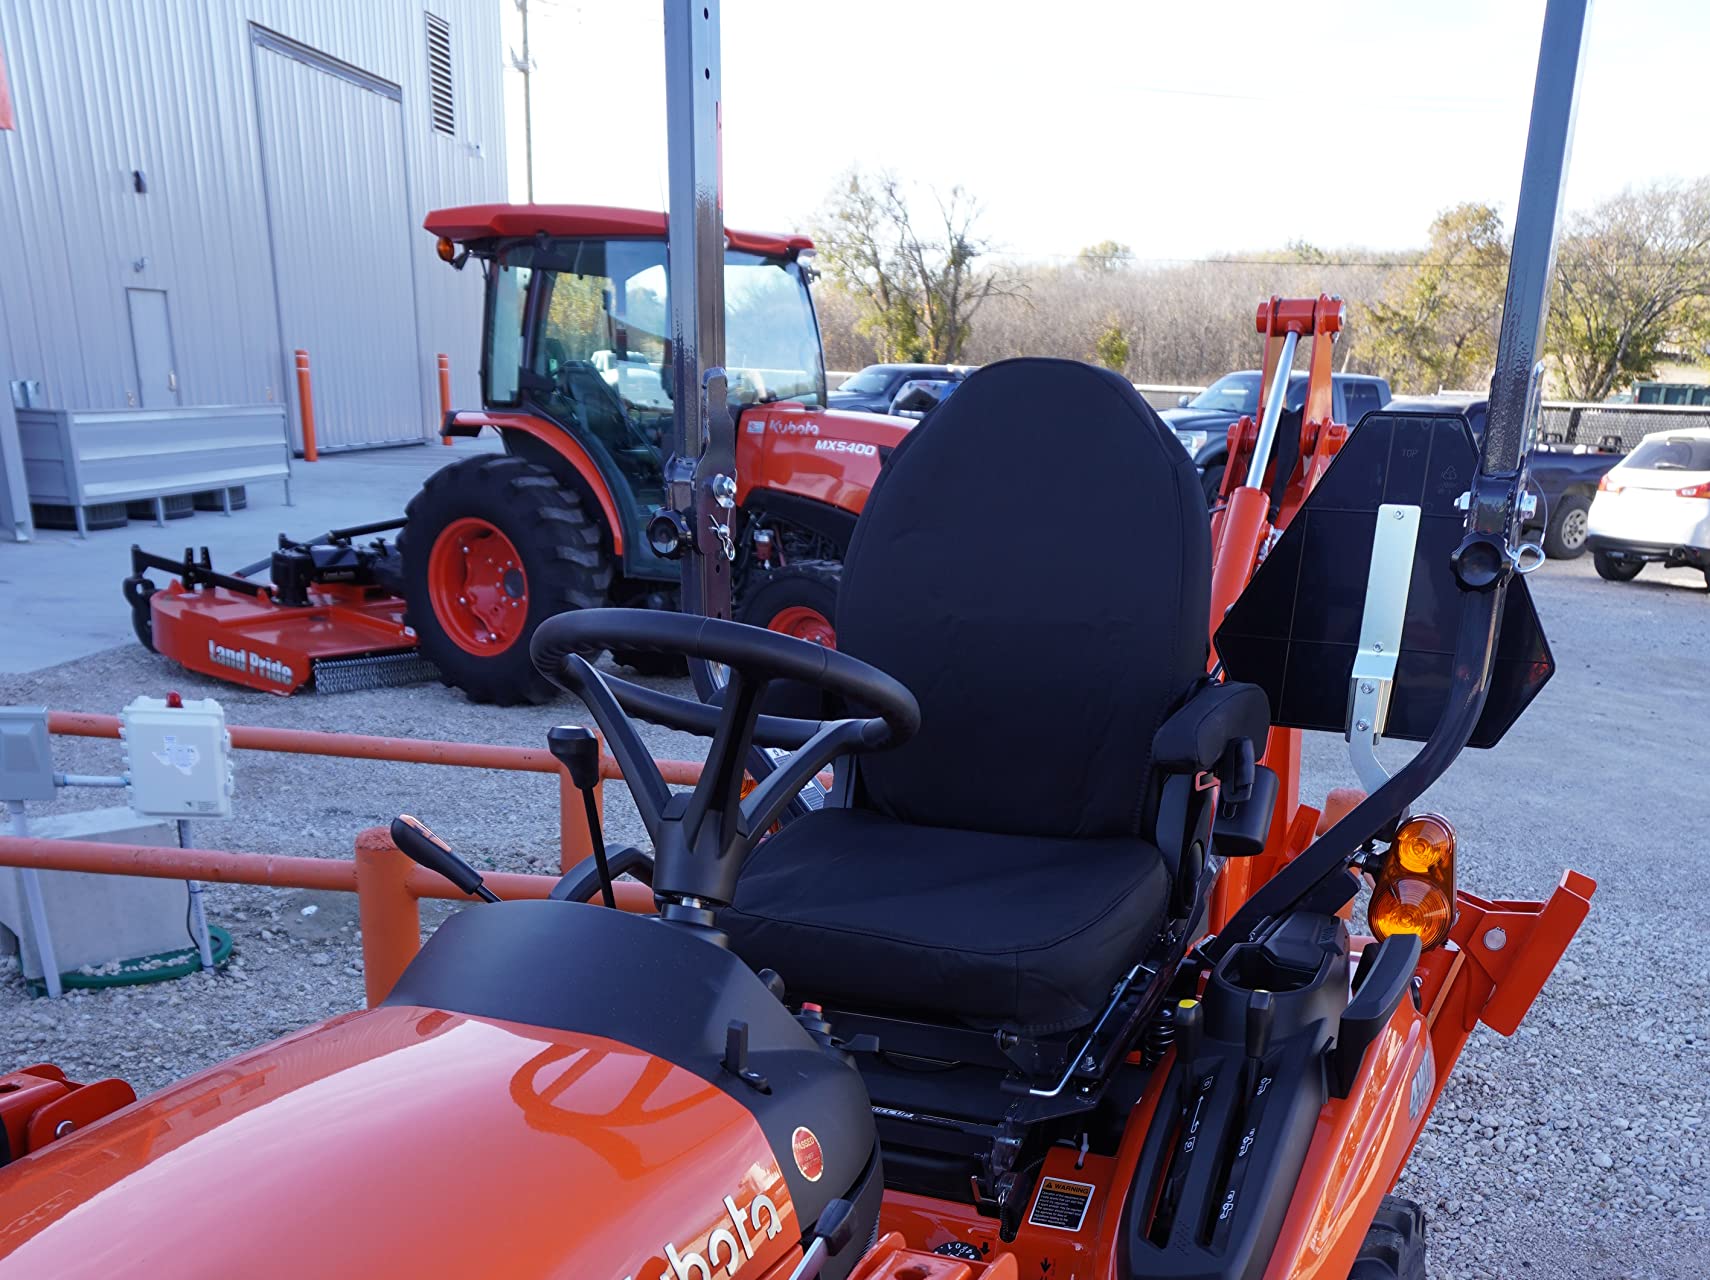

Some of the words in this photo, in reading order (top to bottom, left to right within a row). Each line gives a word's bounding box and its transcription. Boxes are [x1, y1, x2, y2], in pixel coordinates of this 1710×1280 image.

[769, 419, 819, 436] Kubota
[815, 439, 877, 456] MX5400
[208, 639, 247, 672] Land
[248, 651, 293, 686] Pride
[1054, 1183, 1089, 1194] WARNING
